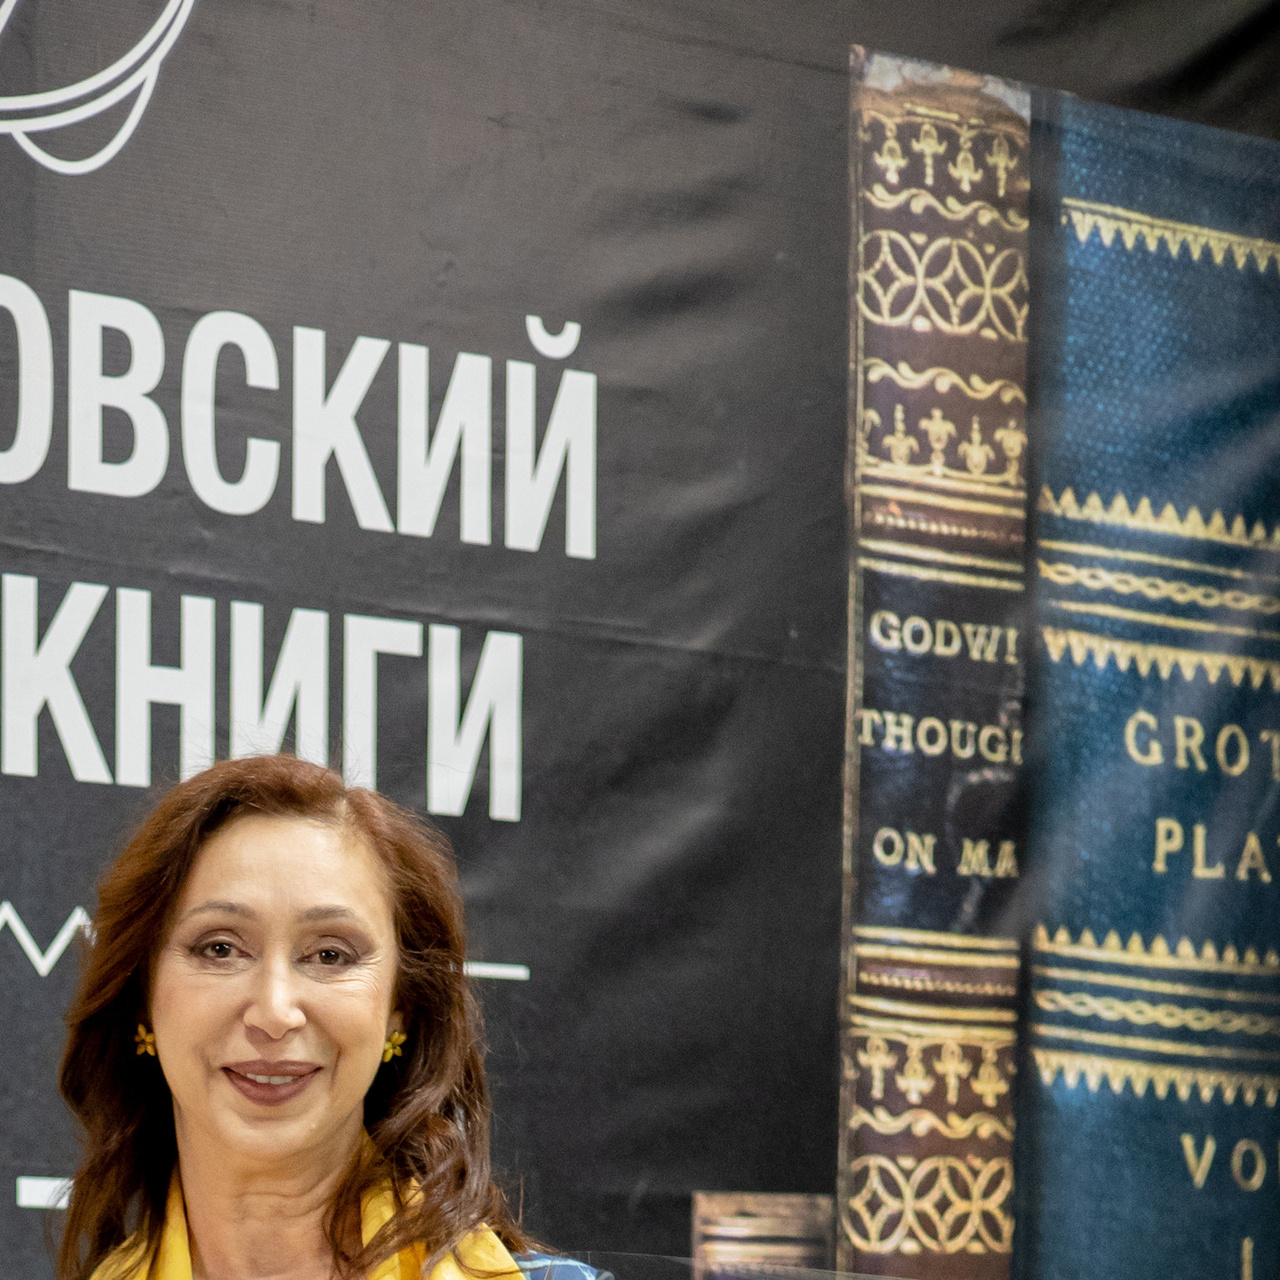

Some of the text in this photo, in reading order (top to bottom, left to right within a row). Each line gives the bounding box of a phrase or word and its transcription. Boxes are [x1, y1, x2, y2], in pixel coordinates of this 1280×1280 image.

[1, 572, 523, 822] КНИГИ
[872, 825, 937, 876] ON
[1152, 816, 1280, 883] PLA
[1180, 1133, 1280, 1191] VO
